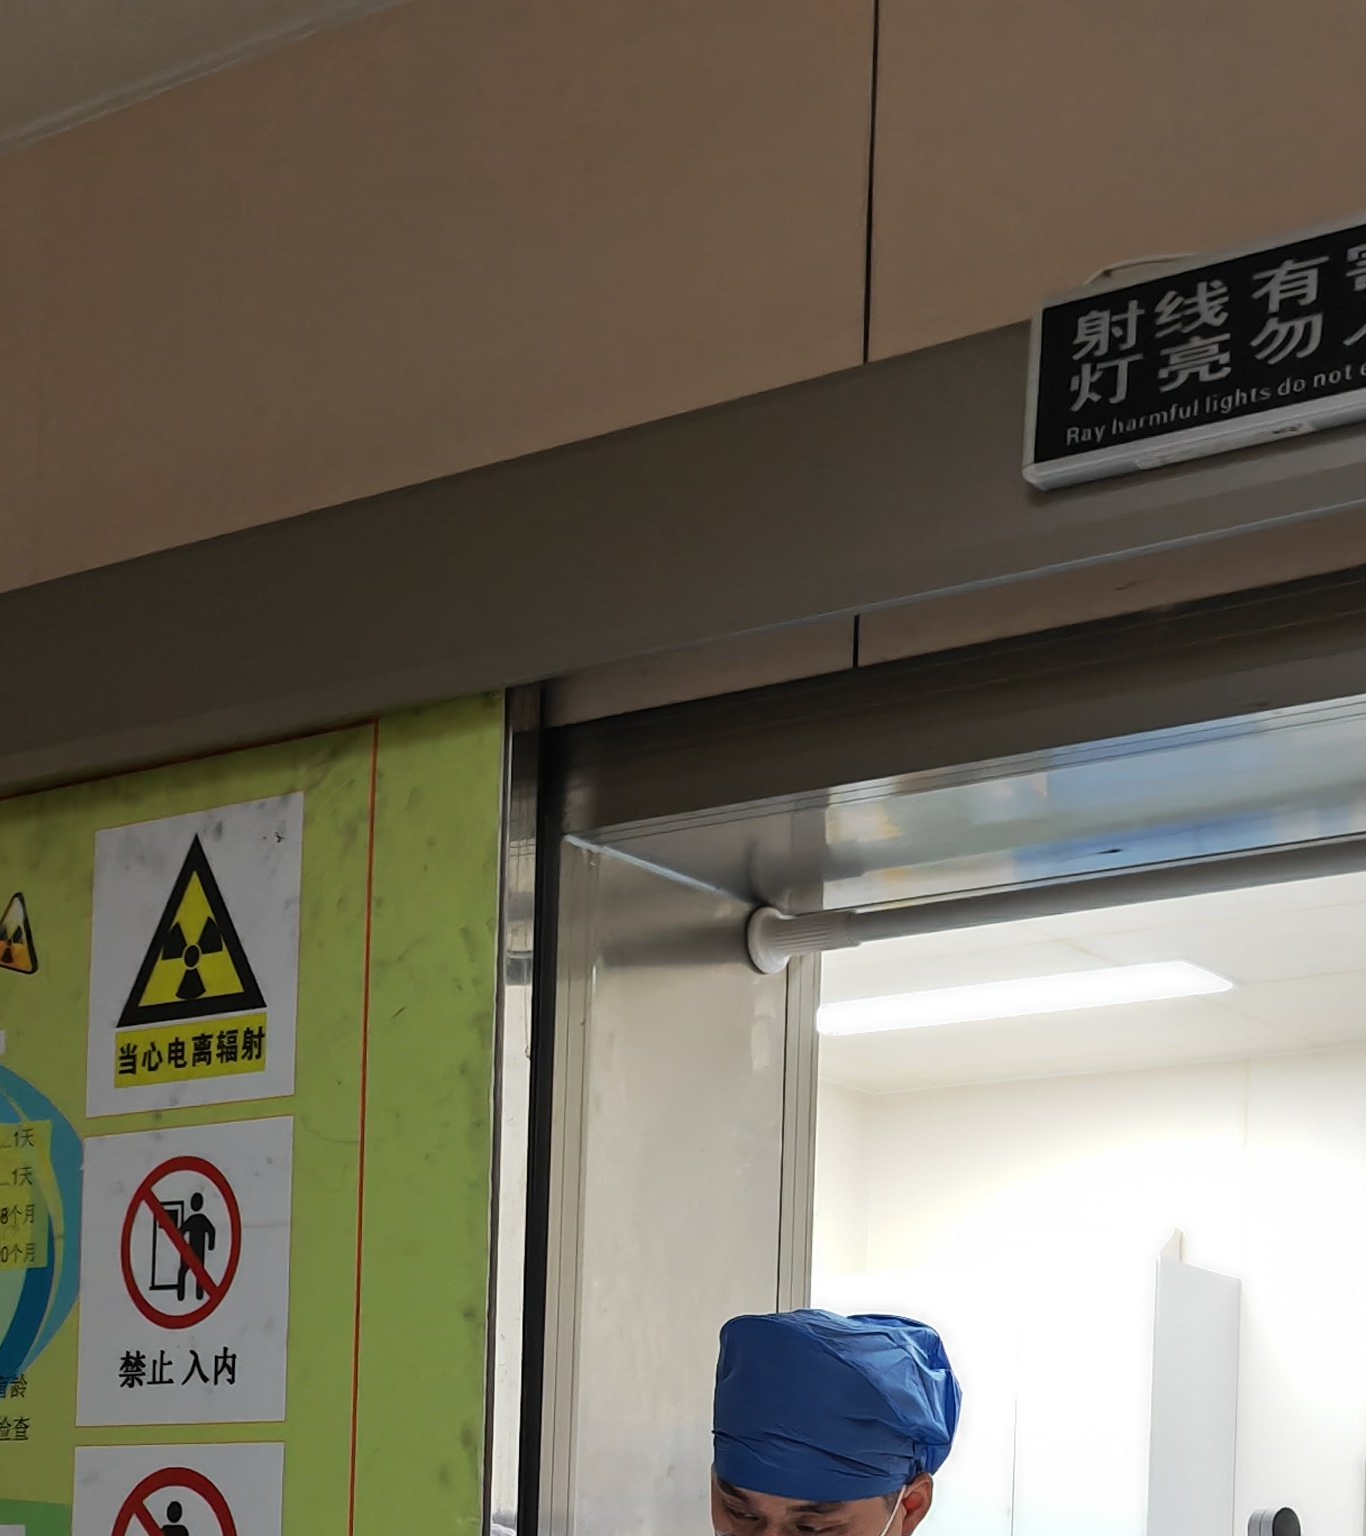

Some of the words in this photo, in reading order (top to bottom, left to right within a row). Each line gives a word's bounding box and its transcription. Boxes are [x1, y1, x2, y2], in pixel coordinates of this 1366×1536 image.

[1067, 424, 1107, 446] Ray
[1112, 398, 1200, 436] harmful
[1206, 387, 1272, 415] lights
[1278, 376, 1306, 397] do
[1314, 364, 1353, 388] not
[118, 1026, 265, 1075] 当心电离辐射
[0, 1204, 35, 1225] 8个月
[118, 1347, 238, 1389] 禁止入内
